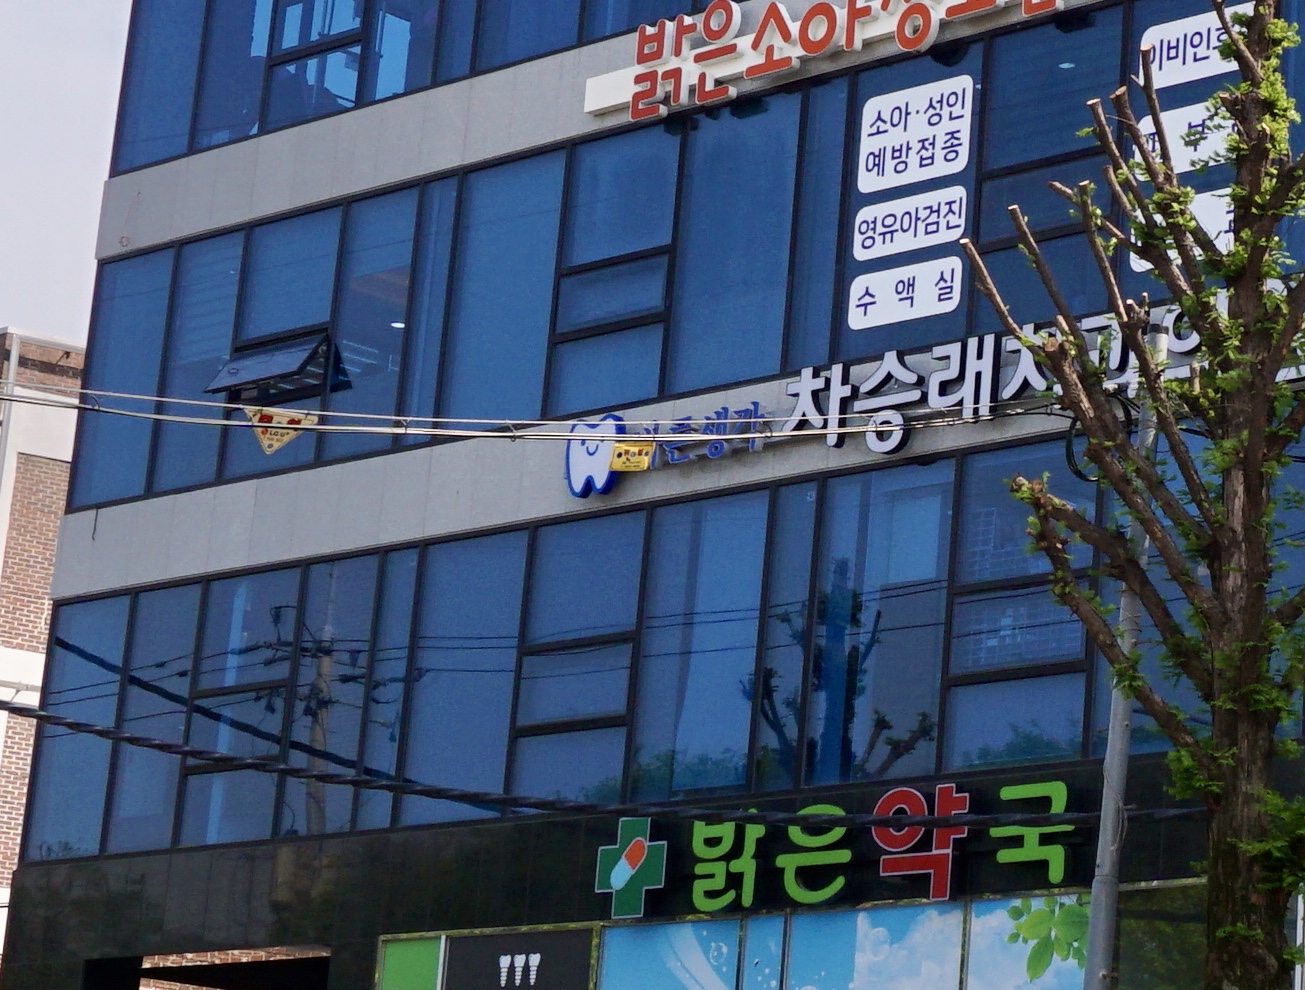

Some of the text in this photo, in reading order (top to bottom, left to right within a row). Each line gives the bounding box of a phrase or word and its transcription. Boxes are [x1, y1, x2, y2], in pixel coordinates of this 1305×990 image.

[866, 87, 966, 138] 소아·성인
[865, 129, 963, 177] 예방접종
[858, 197, 963, 250] 영유아검진
